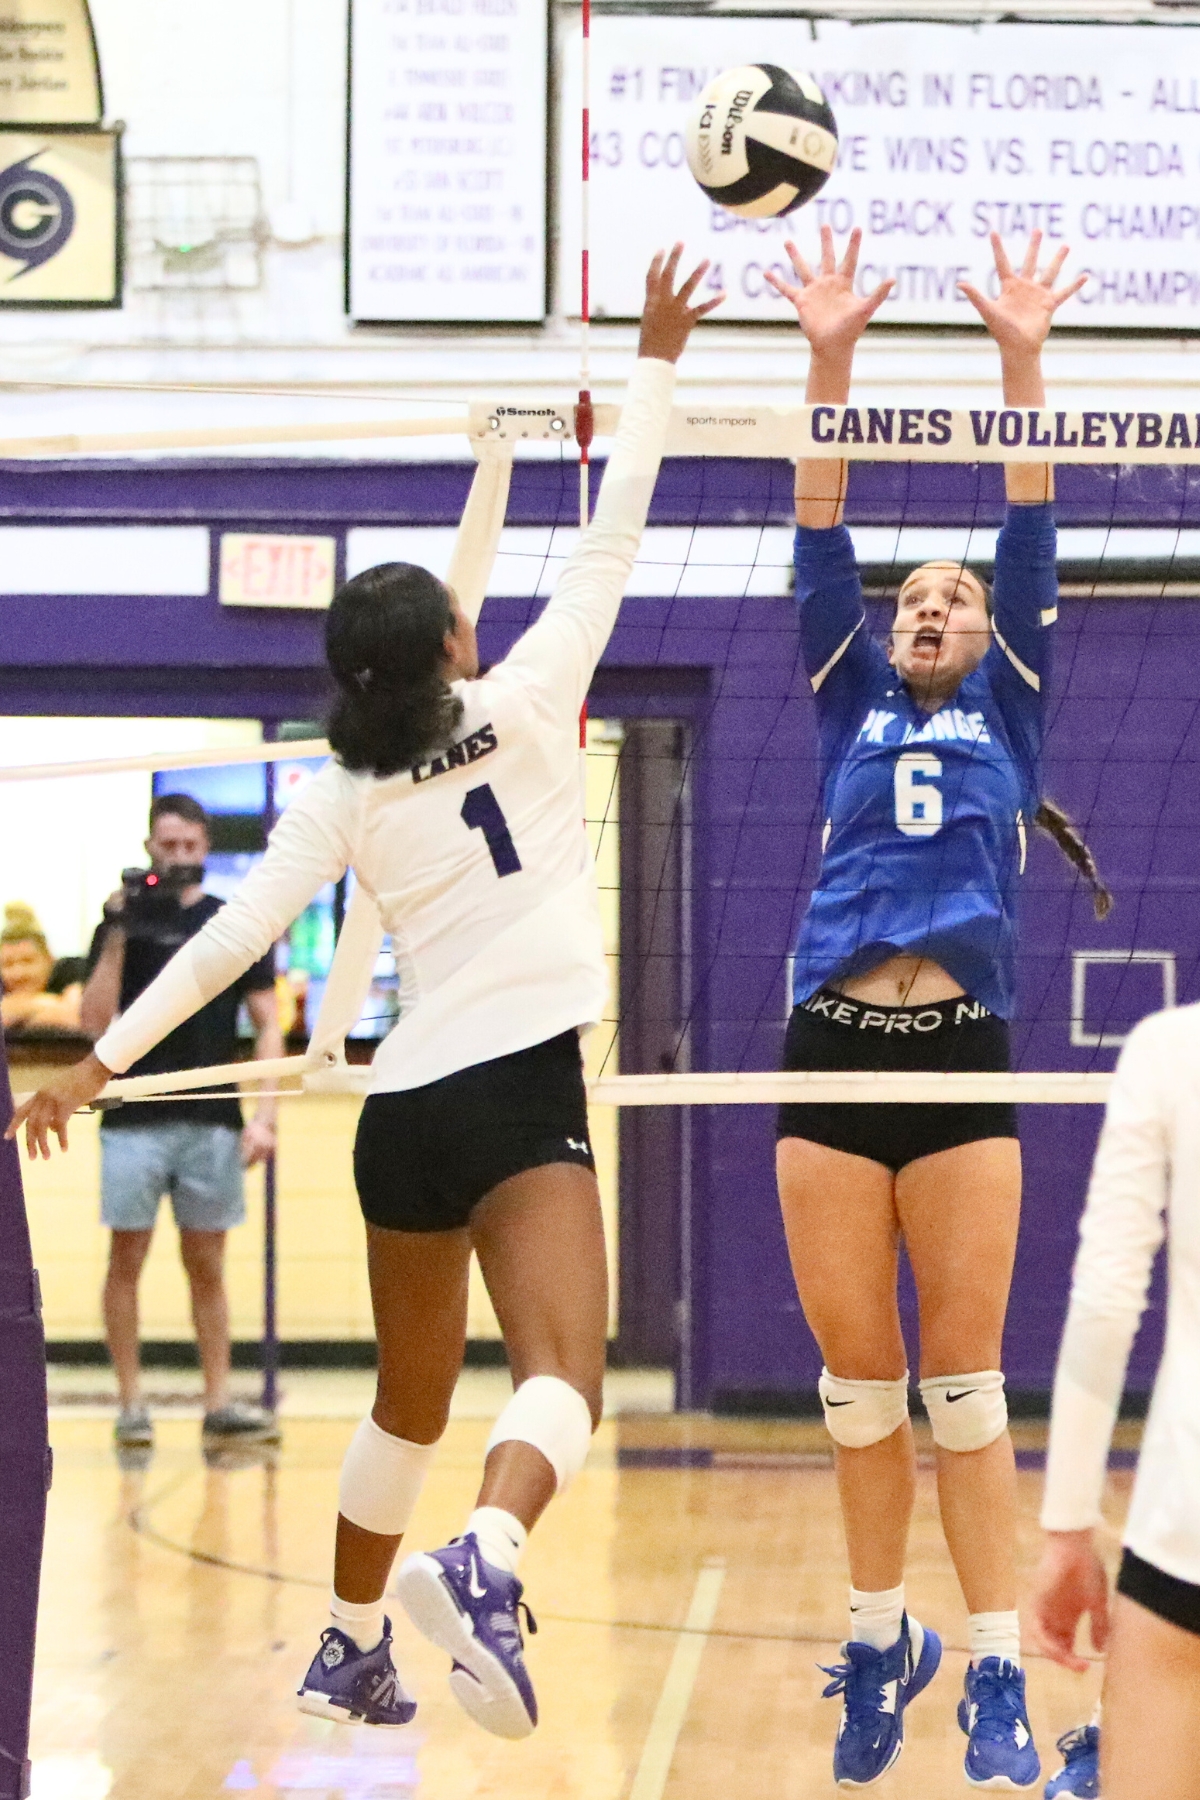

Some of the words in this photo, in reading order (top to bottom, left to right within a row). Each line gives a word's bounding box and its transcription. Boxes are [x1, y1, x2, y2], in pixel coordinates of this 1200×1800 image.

[610, 68, 643, 102] #1
[922, 73, 954, 107] IN
[969, 74, 1102, 111] FLORIDA
[721, 90, 754, 155] Wilson
[884, 136, 968, 175] WINS
[982, 136, 1034, 177] VS.
[1050, 138, 1185, 178] FLORIDA
[814, 198, 855, 235] TO
[868, 199, 956, 237] BACK
[972, 200, 1063, 239] STATE
[706, 262, 724, 292] 4
[507, 407, 556, 416] Senoh
[686, 416, 717, 426] sports
[719, 417, 757, 428] imports
[811, 407, 952, 445] CANES
[970, 410, 1200, 449] VOLLEYBA
[243, 543, 316, 597] EXIT
[894, 752, 943, 836] 6
[460, 783, 522, 878] 1
[801, 993, 859, 1025] IKE
[859, 1010, 943, 1034] PRO
